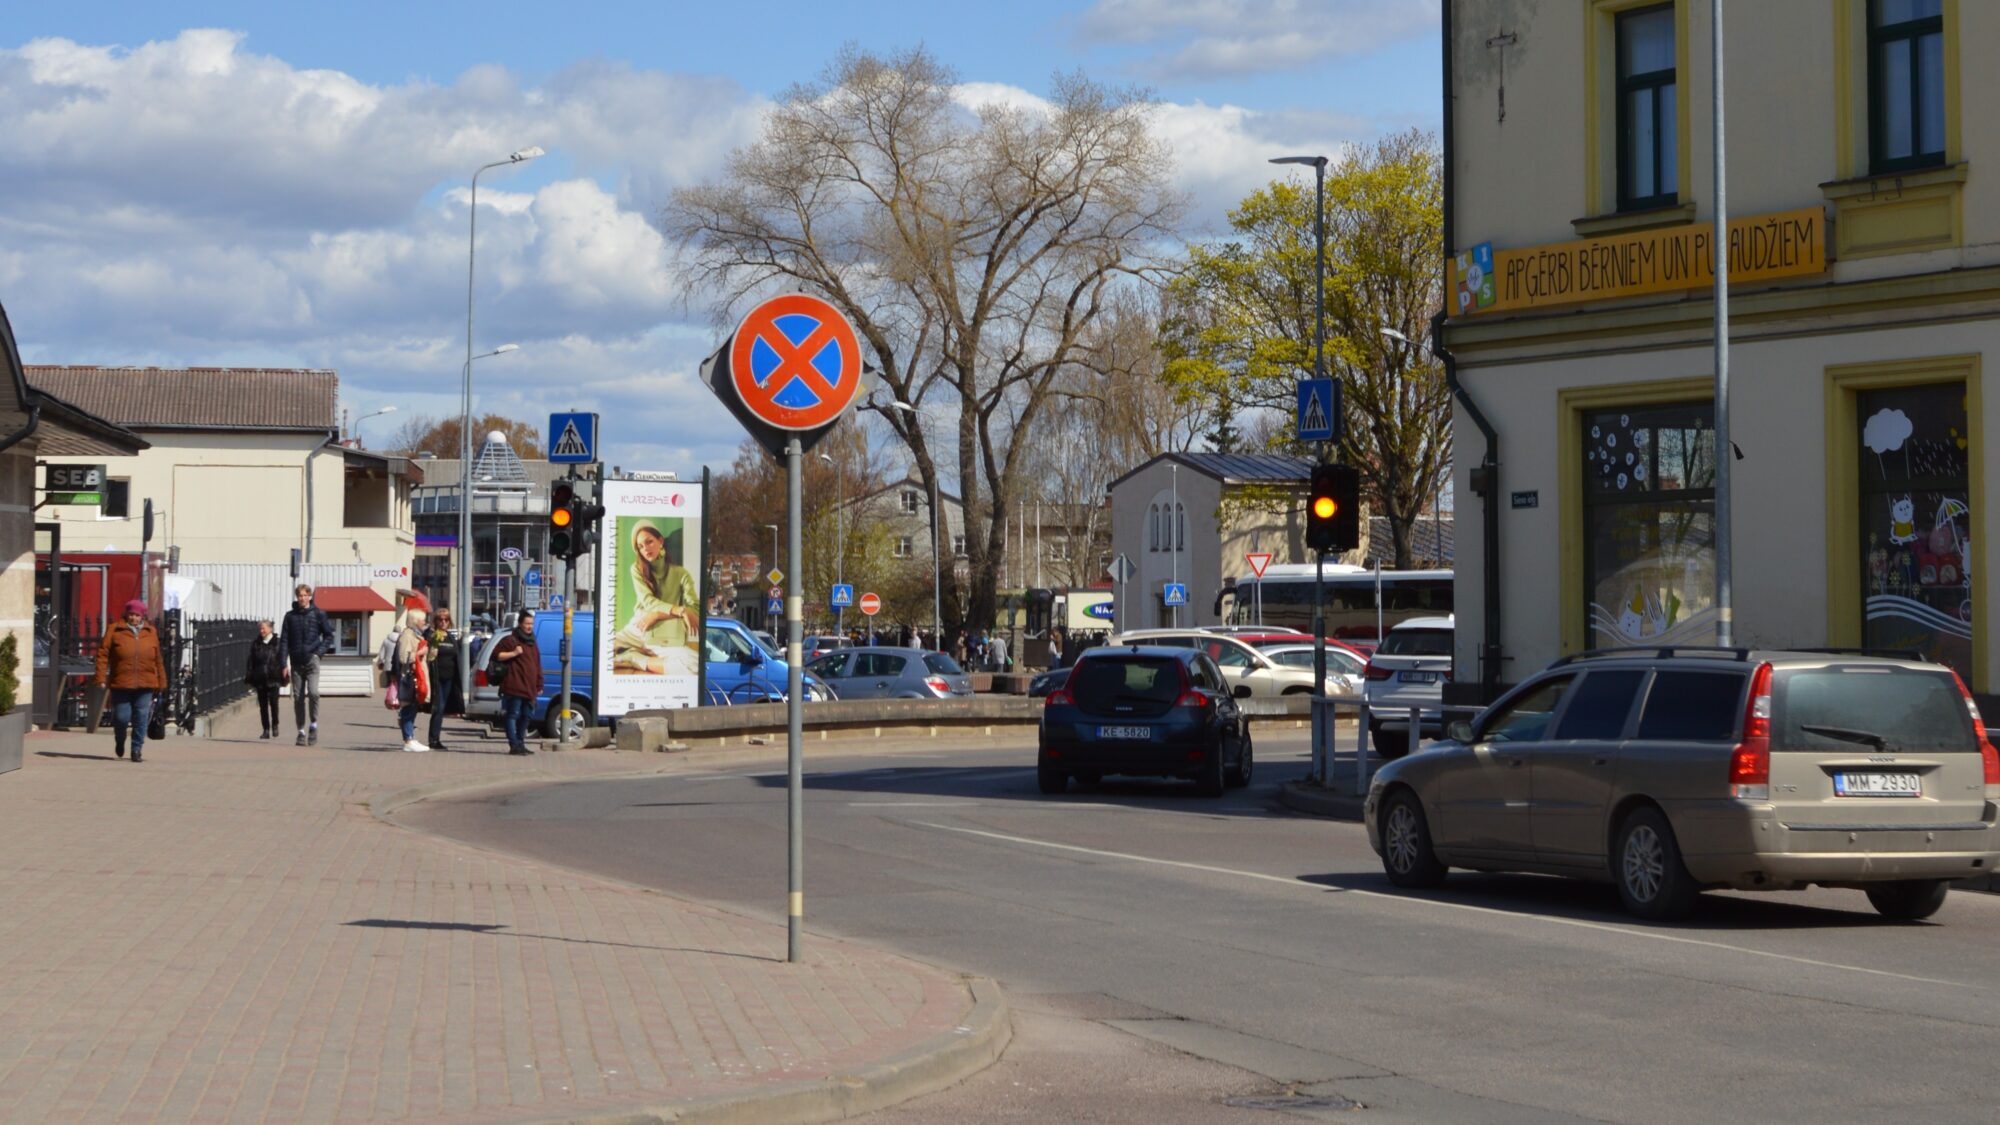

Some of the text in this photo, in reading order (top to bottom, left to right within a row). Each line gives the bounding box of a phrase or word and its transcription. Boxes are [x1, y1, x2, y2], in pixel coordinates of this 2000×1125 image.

[1505, 217, 1814, 304] APĢĒRBI BĒRNIEM UN PUAUDŽIEM
[53, 469, 101, 485] SEB
[621, 495, 670, 505] KURZEME
[1846, 775, 1918, 791] MM-2930
